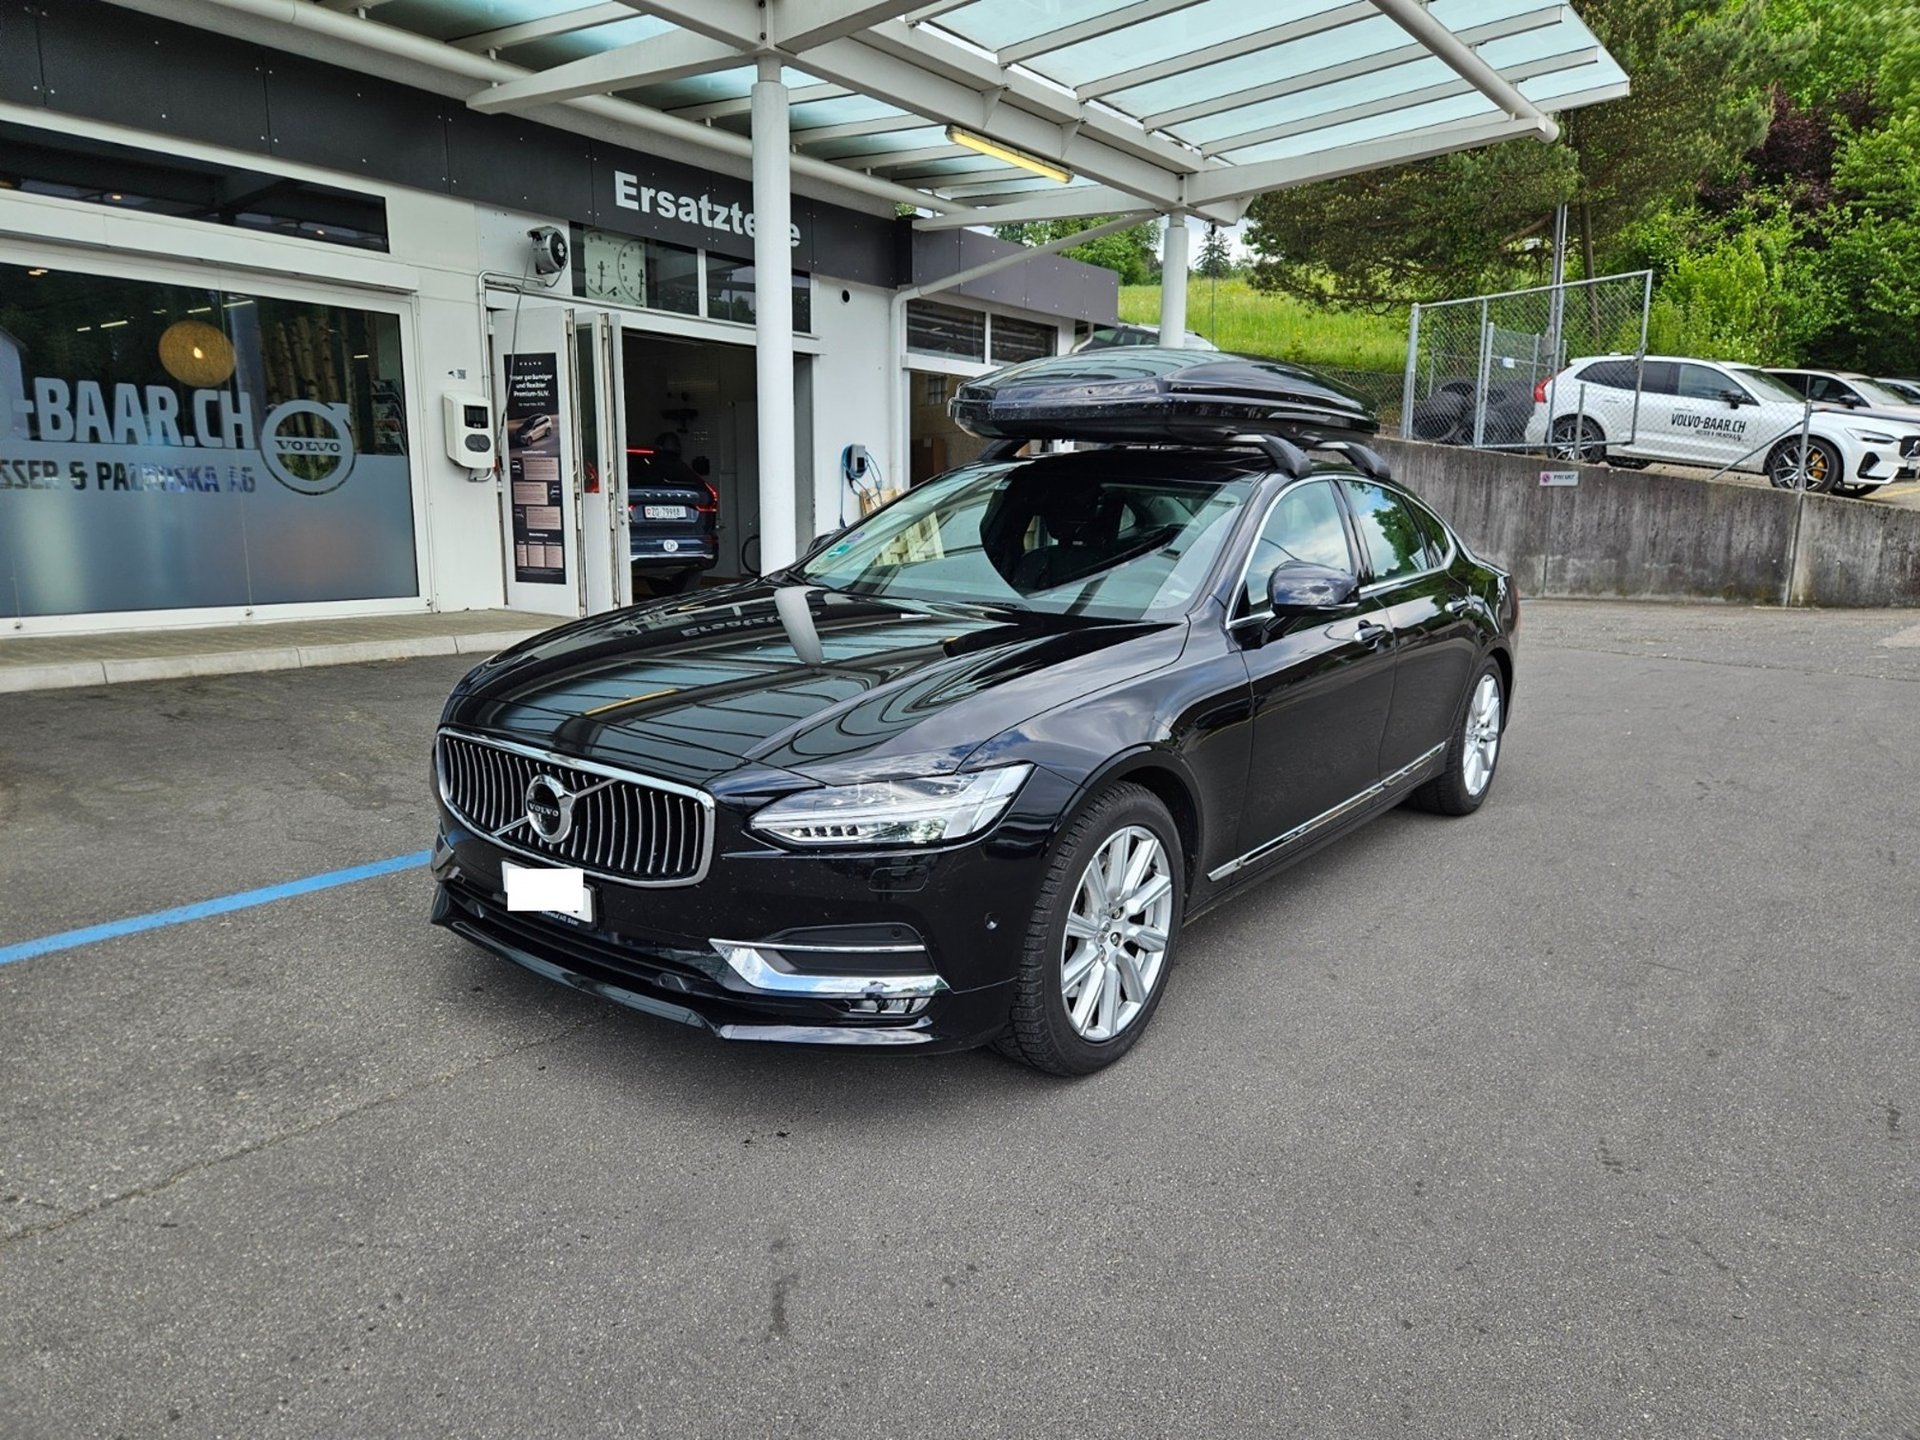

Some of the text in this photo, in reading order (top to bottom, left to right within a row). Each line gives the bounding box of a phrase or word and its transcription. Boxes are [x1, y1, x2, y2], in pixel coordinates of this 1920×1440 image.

[614, 170, 801, 247] Ersatztee
[1671, 413, 1746, 434] VOLVO-BAAR.CH
[276, 439, 341, 453] VOLVO
[69, 461, 88, 490] &
[529, 803, 559, 817] VOLVO
